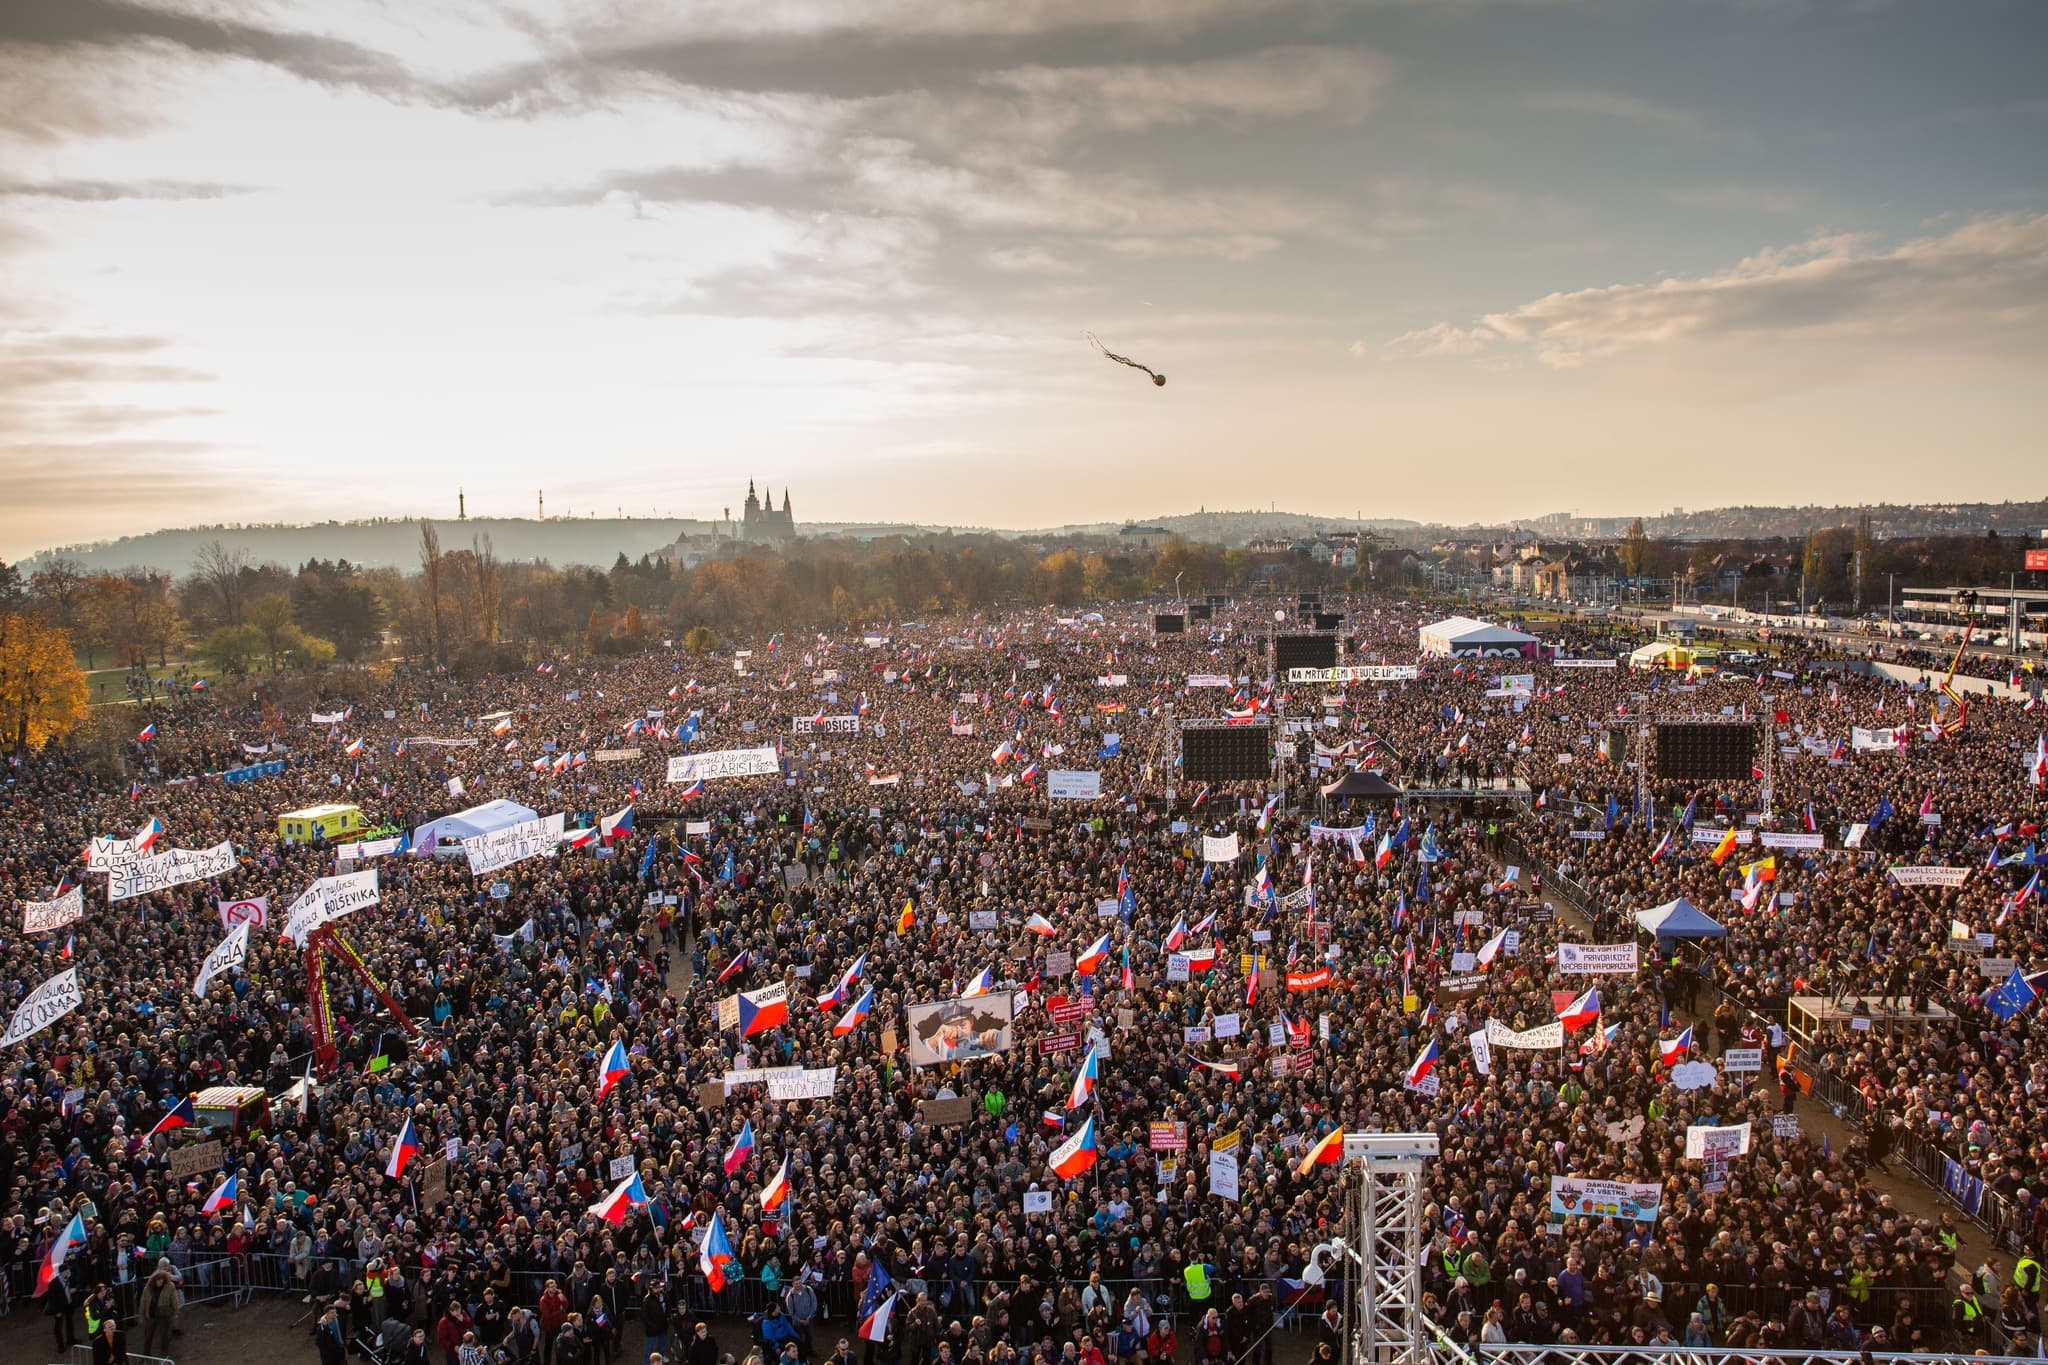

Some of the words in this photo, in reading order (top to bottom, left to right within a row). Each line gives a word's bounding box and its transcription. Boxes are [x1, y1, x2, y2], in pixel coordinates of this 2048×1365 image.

[1291, 669, 1302, 679] NA
[1351, 667, 1379, 678] NEBUDE
[754, 984, 785, 1004] JAROMĚŘ
